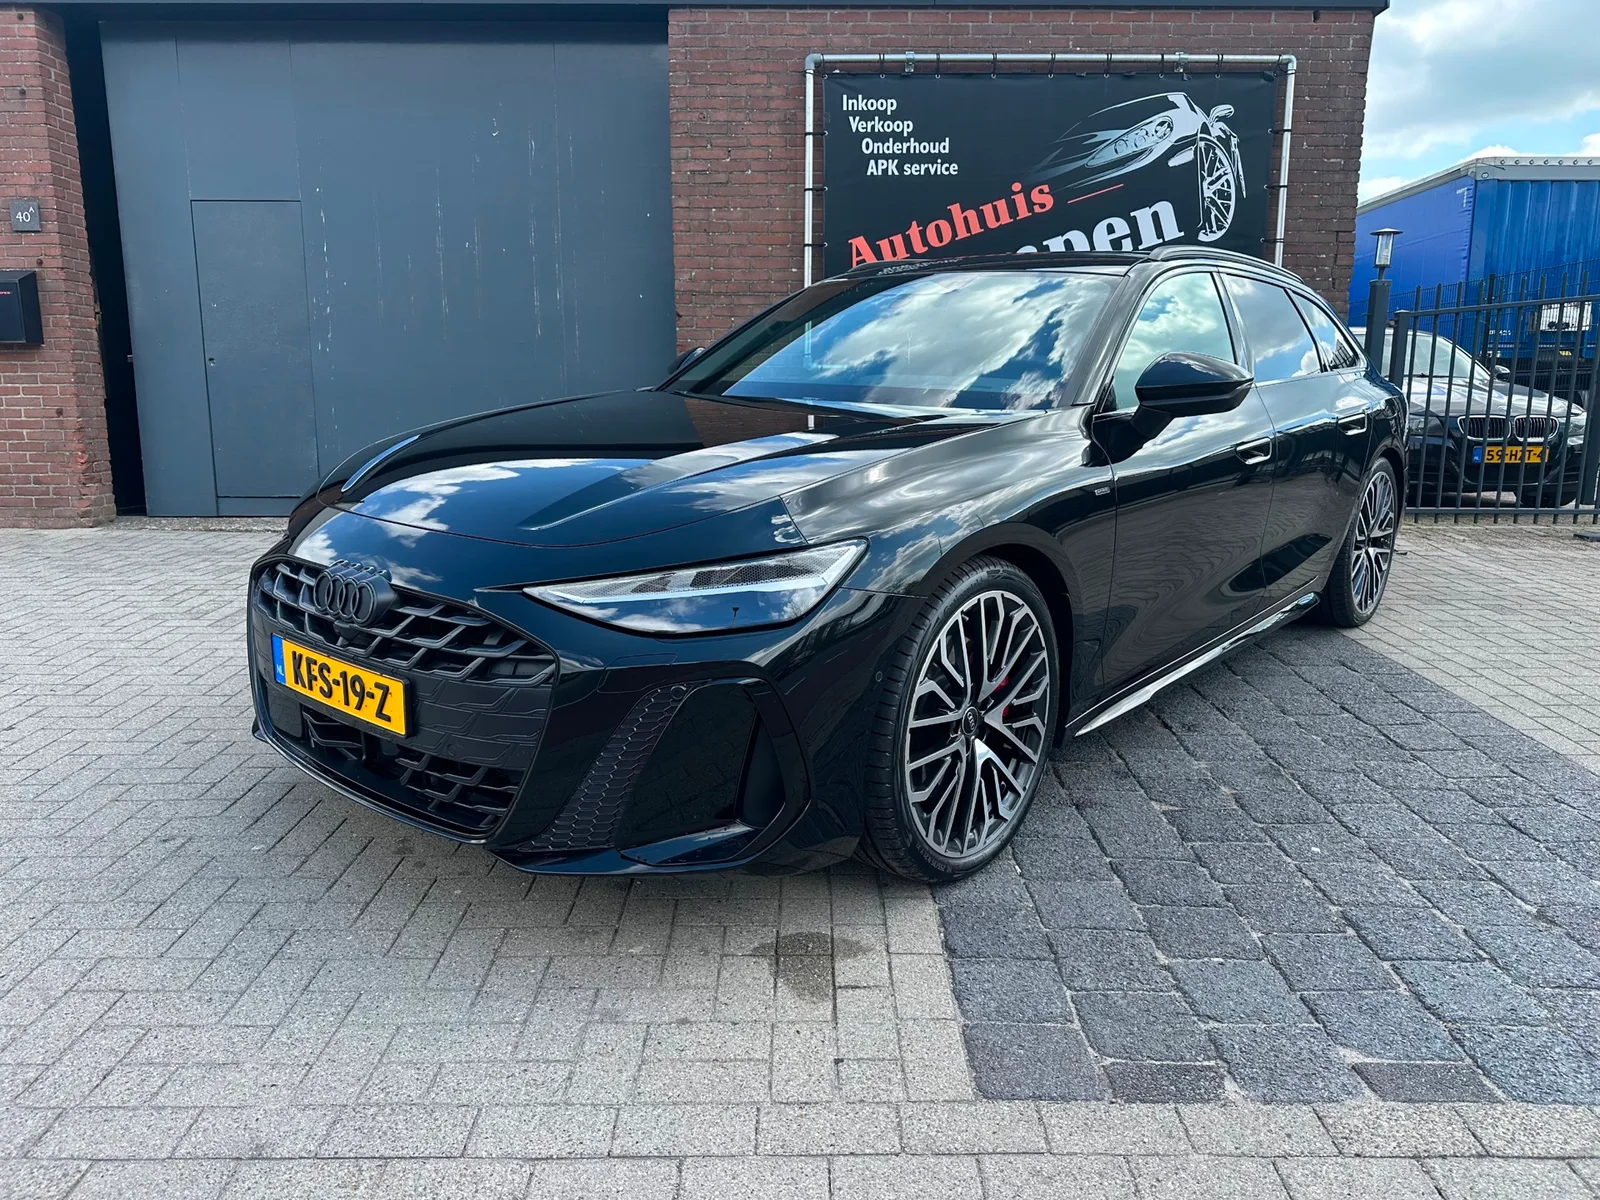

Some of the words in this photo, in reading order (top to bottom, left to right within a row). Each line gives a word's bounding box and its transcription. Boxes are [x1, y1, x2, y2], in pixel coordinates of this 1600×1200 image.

[842, 94, 898, 116] Inkoop
[848, 116, 914, 137] Verkoop
[861, 137, 950, 155] Onderhoud
[866, 159, 900, 176] APK
[903, 158, 959, 176] service
[848, 181, 1055, 268] Autohuis
[276, 664, 285, 677] NL
[291, 650, 392, 723] KFS-19-Z
